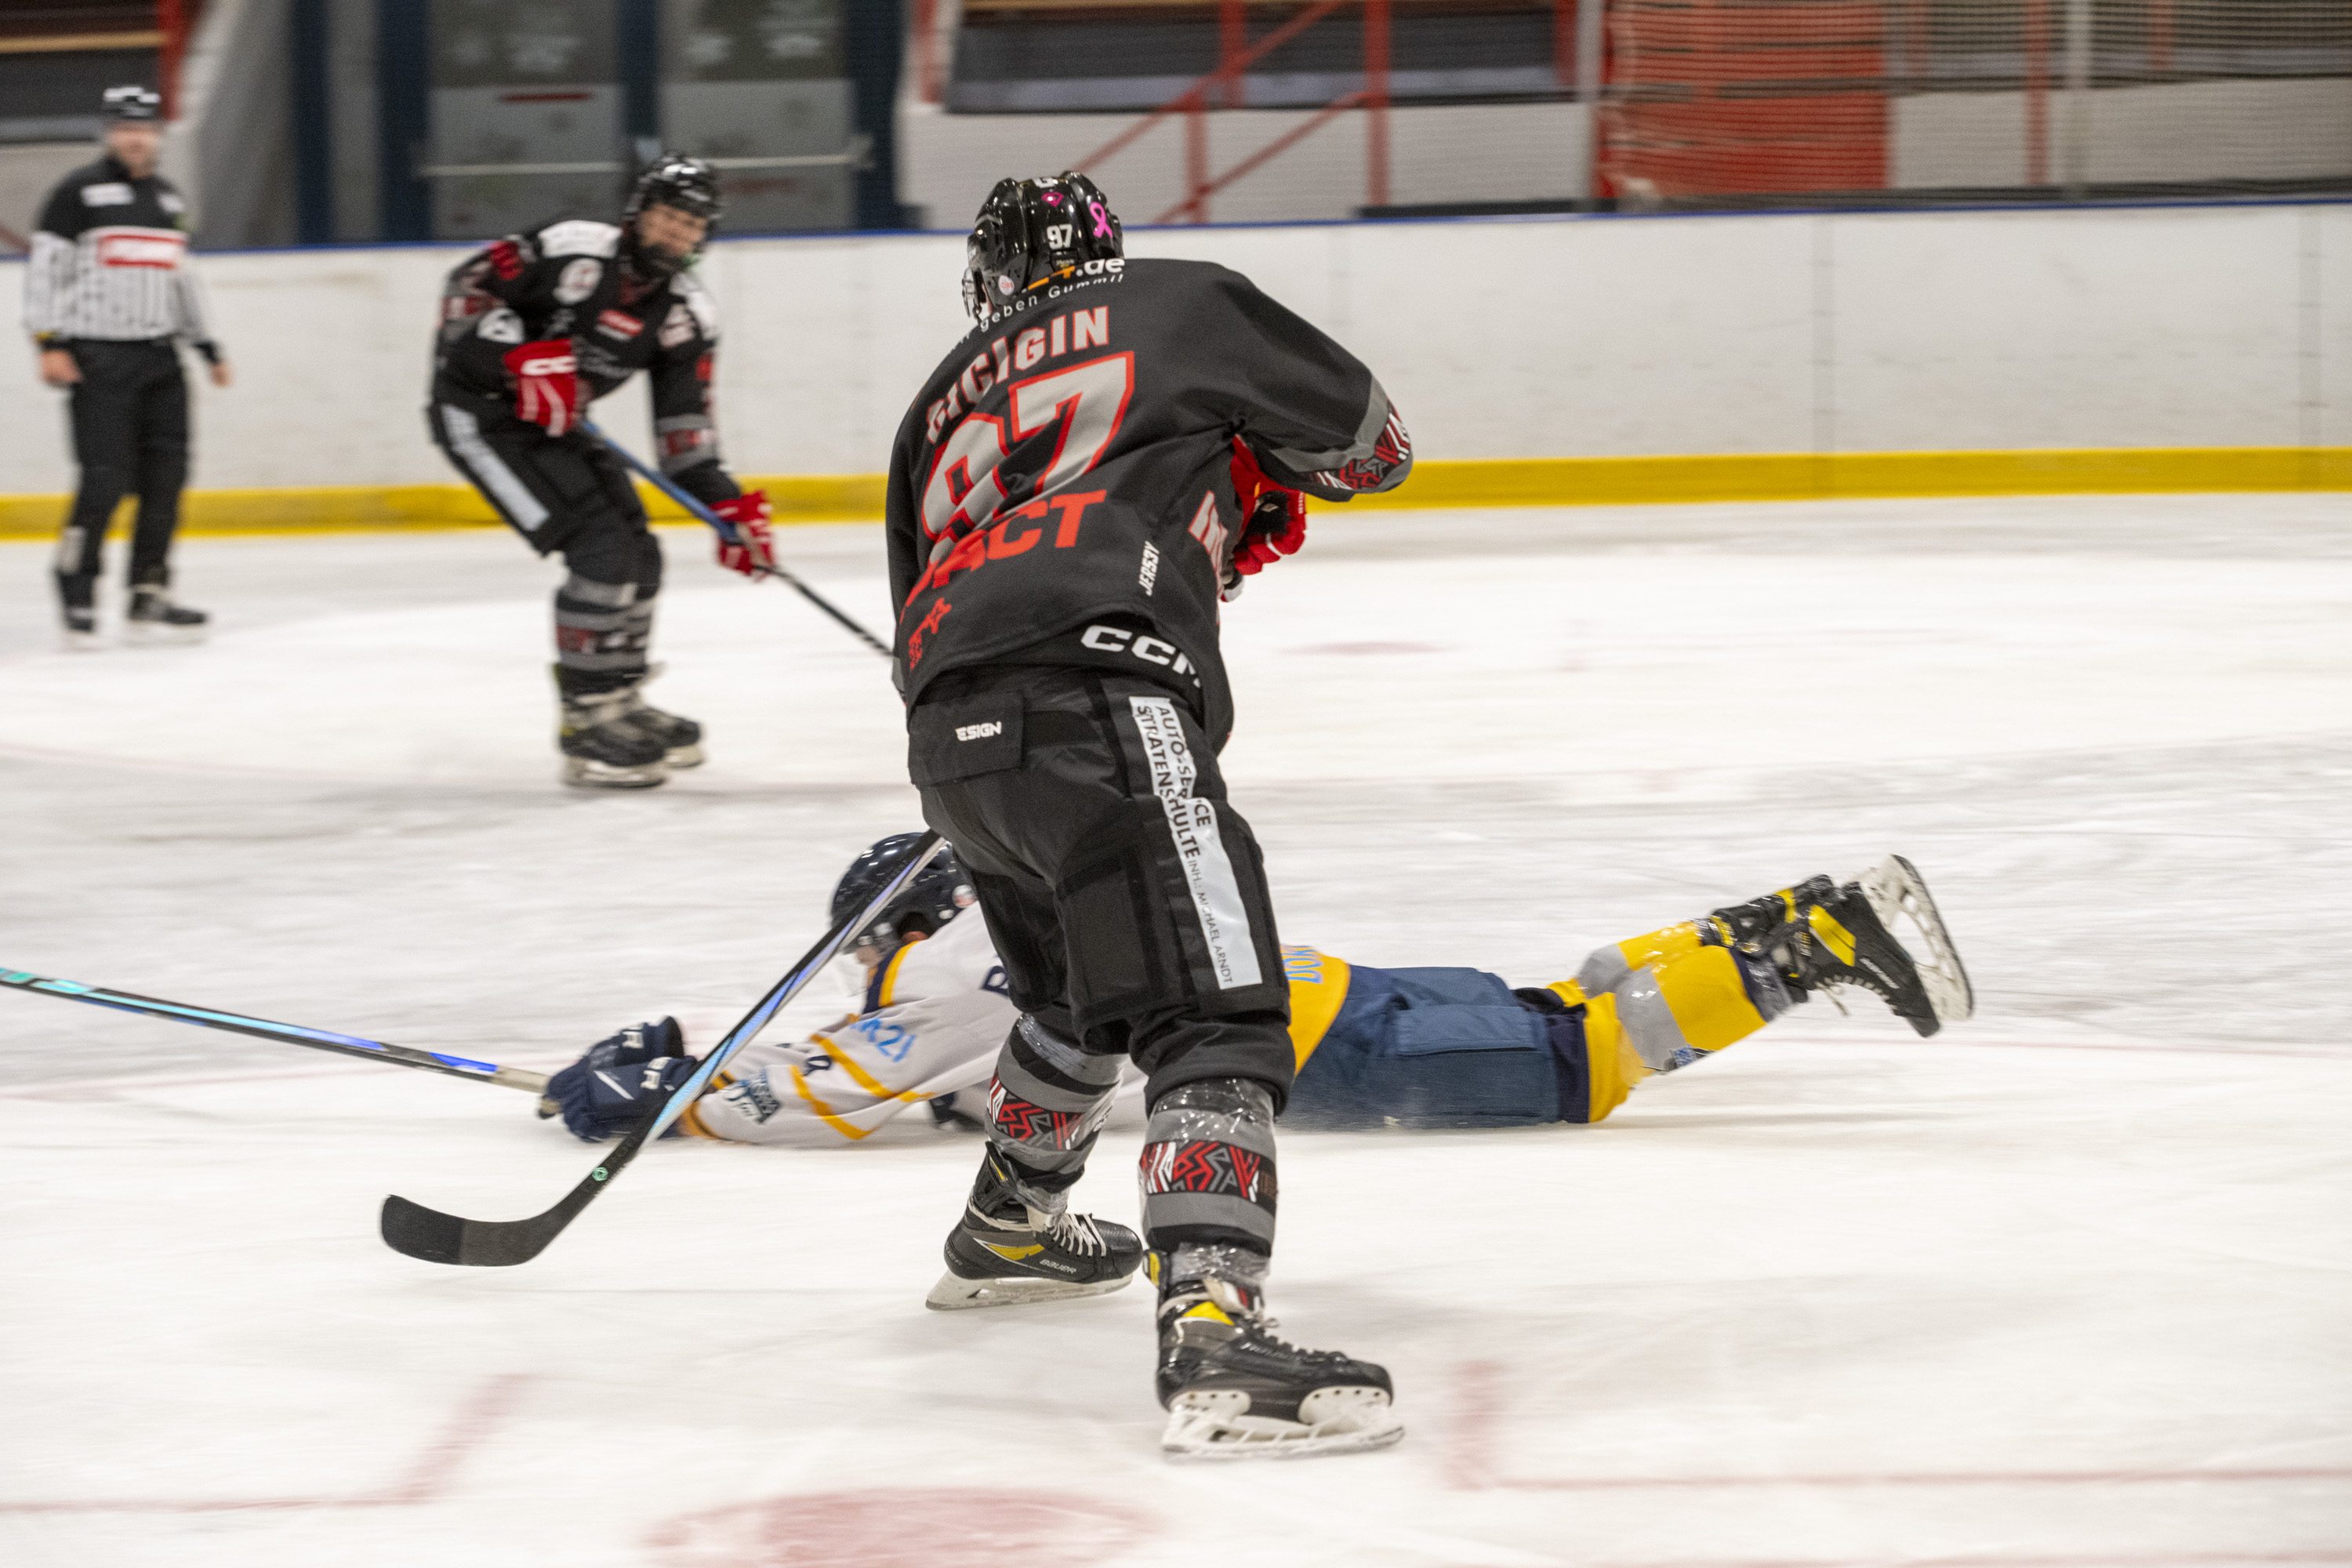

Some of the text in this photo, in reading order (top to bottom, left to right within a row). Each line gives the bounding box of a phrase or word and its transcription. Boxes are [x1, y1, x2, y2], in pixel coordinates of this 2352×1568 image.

[1046, 223, 1073, 250] 97
[979, 294, 1038, 332] geben
[920, 350, 1136, 566] 97
[1196, 891, 1221, 943] MICHAEL
[1213, 946, 1233, 985] ARNDT
[1039, 1258, 1077, 1275] BAUER
